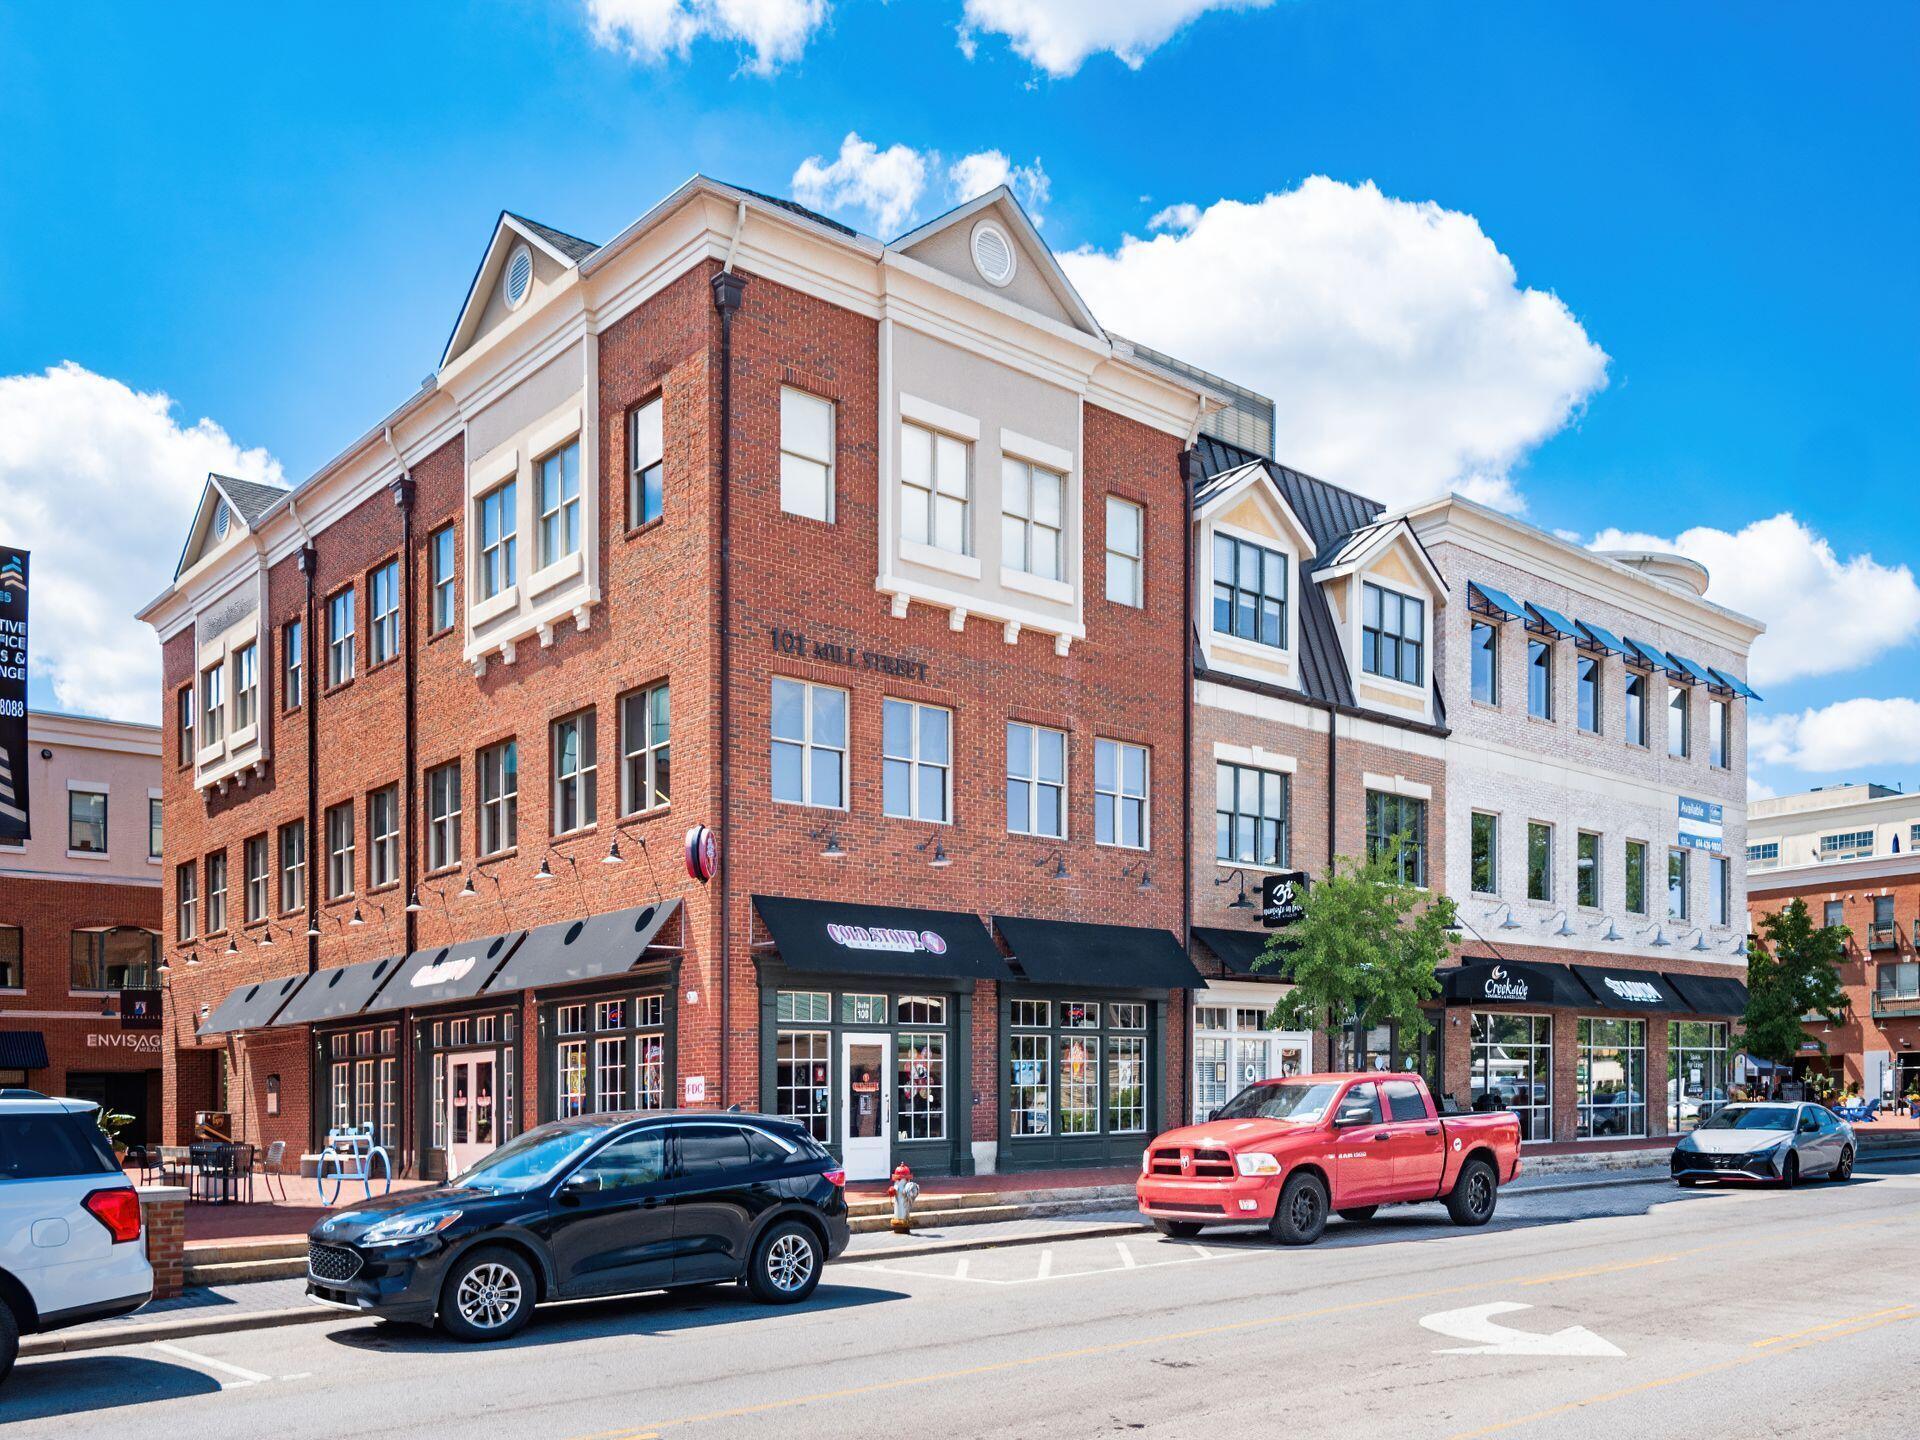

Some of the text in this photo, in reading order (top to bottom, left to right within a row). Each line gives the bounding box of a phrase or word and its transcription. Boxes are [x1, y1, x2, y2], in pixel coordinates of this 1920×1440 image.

[771, 627, 806, 656] 101
[862, 651, 928, 681] STREET
[827, 924, 925, 950] COLD STONE
[1485, 977, 1529, 997] Creekside
